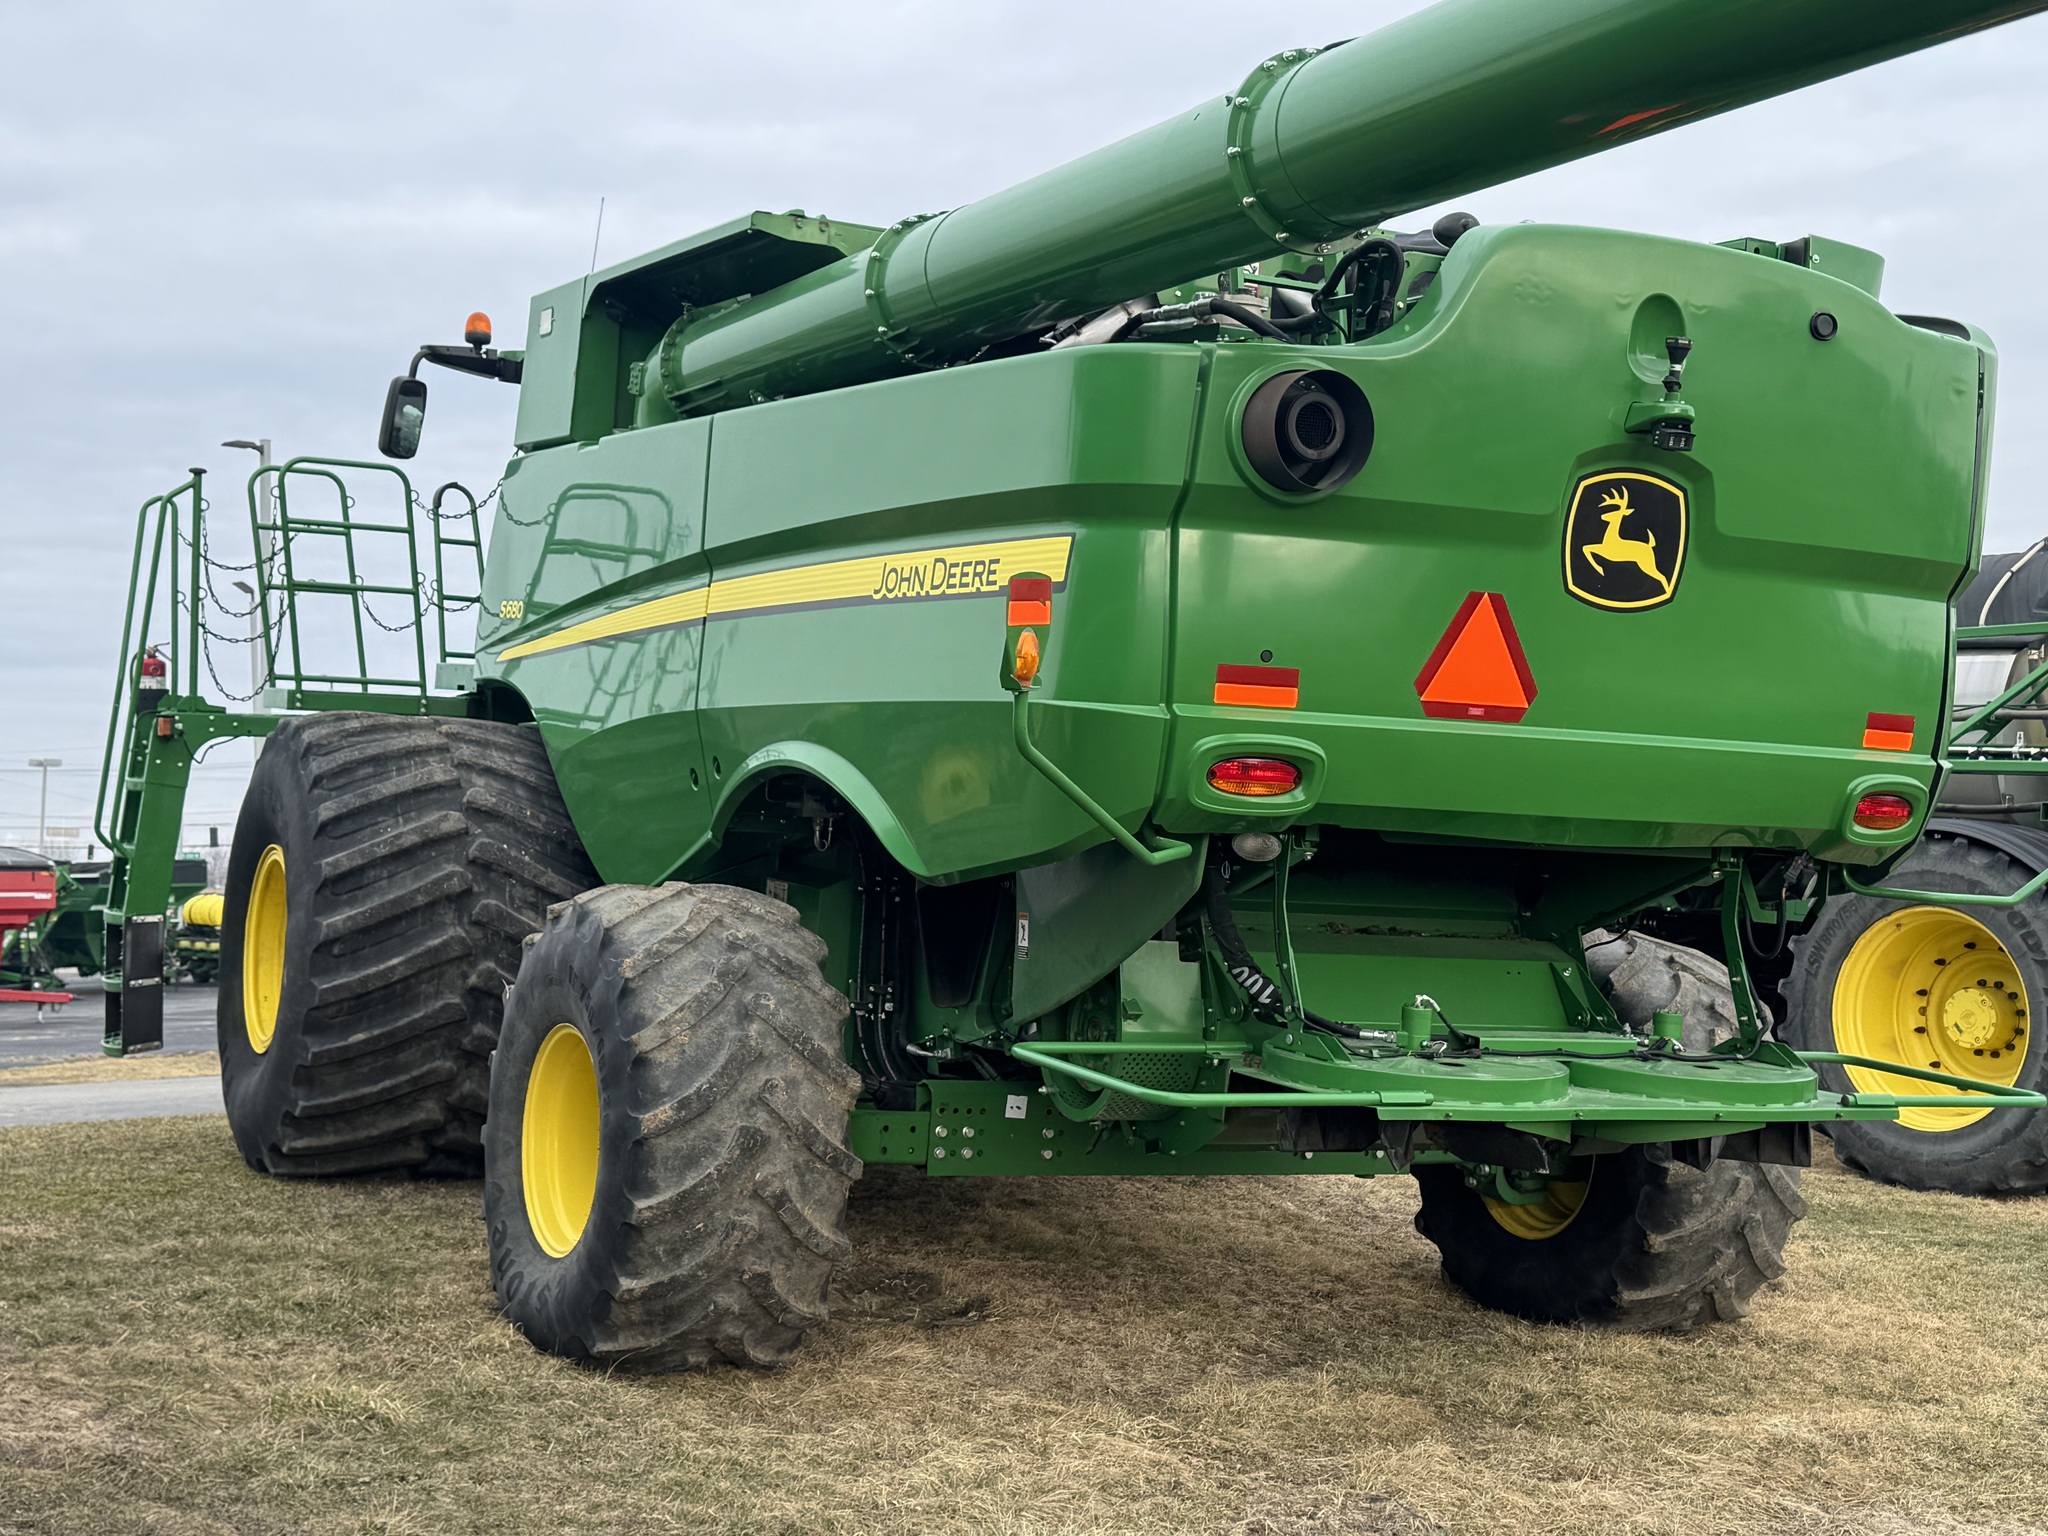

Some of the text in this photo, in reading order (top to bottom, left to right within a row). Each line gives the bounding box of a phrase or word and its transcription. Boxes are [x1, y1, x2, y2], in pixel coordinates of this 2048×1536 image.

[873, 557, 1001, 596] JOHN DEERE
[499, 600, 524, 619] S680
